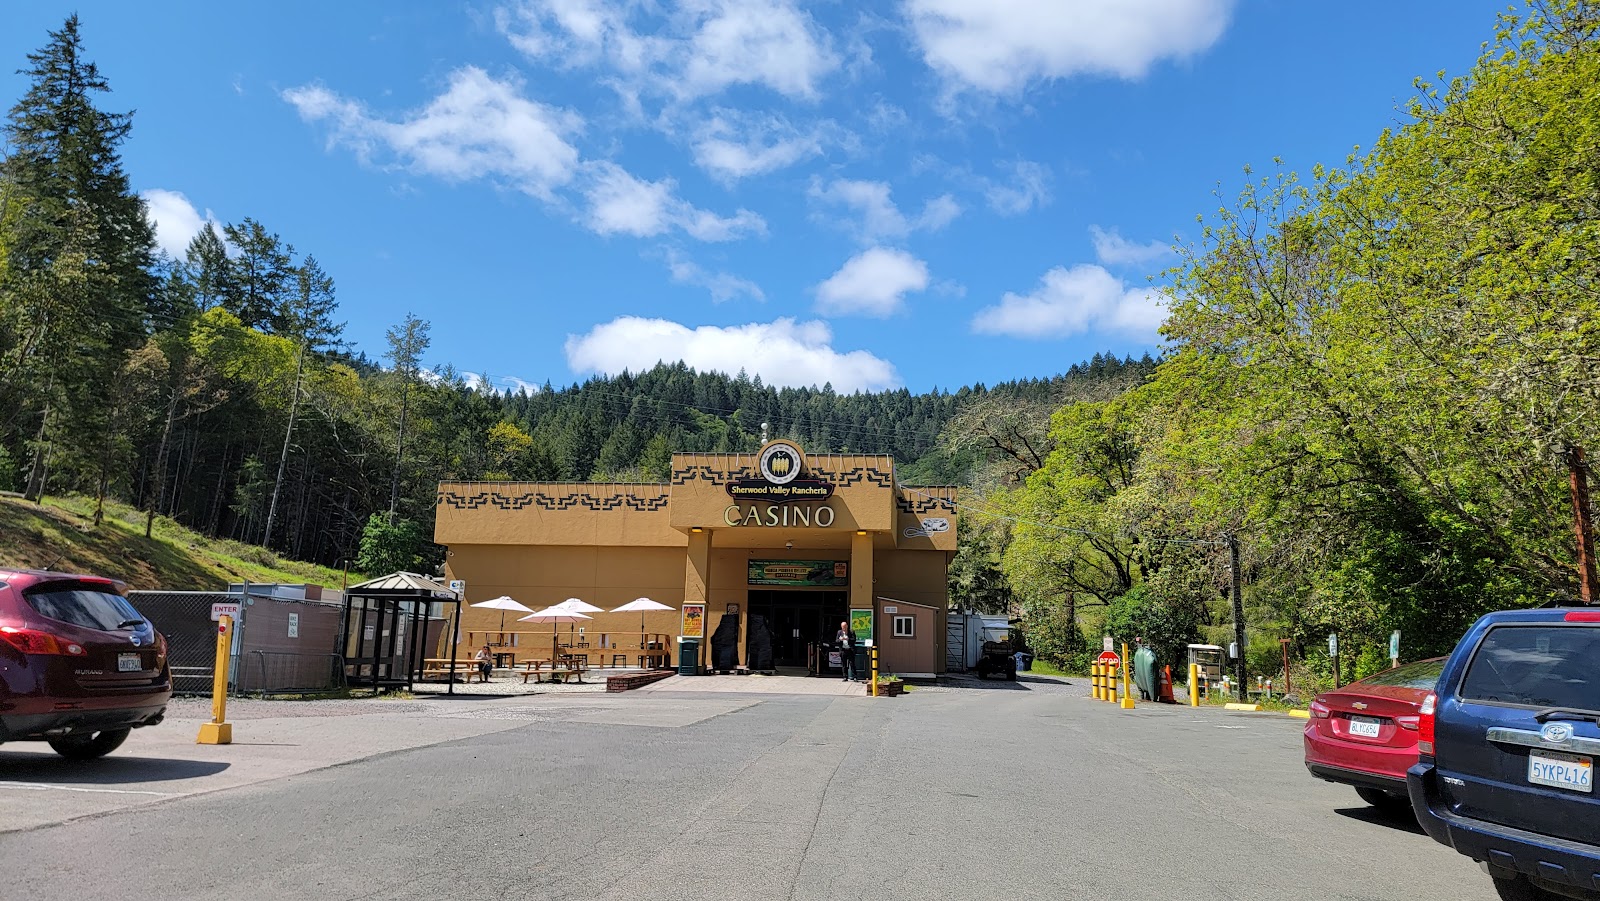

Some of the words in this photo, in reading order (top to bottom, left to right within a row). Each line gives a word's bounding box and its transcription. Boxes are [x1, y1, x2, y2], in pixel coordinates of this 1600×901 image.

[731, 486, 767, 494] Sherwood
[768, 486, 790, 497] Valley
[791, 487, 828, 495] Rancheria
[723, 505, 834, 526] CASINO
[1533, 761, 1589, 785] 5YKP416
